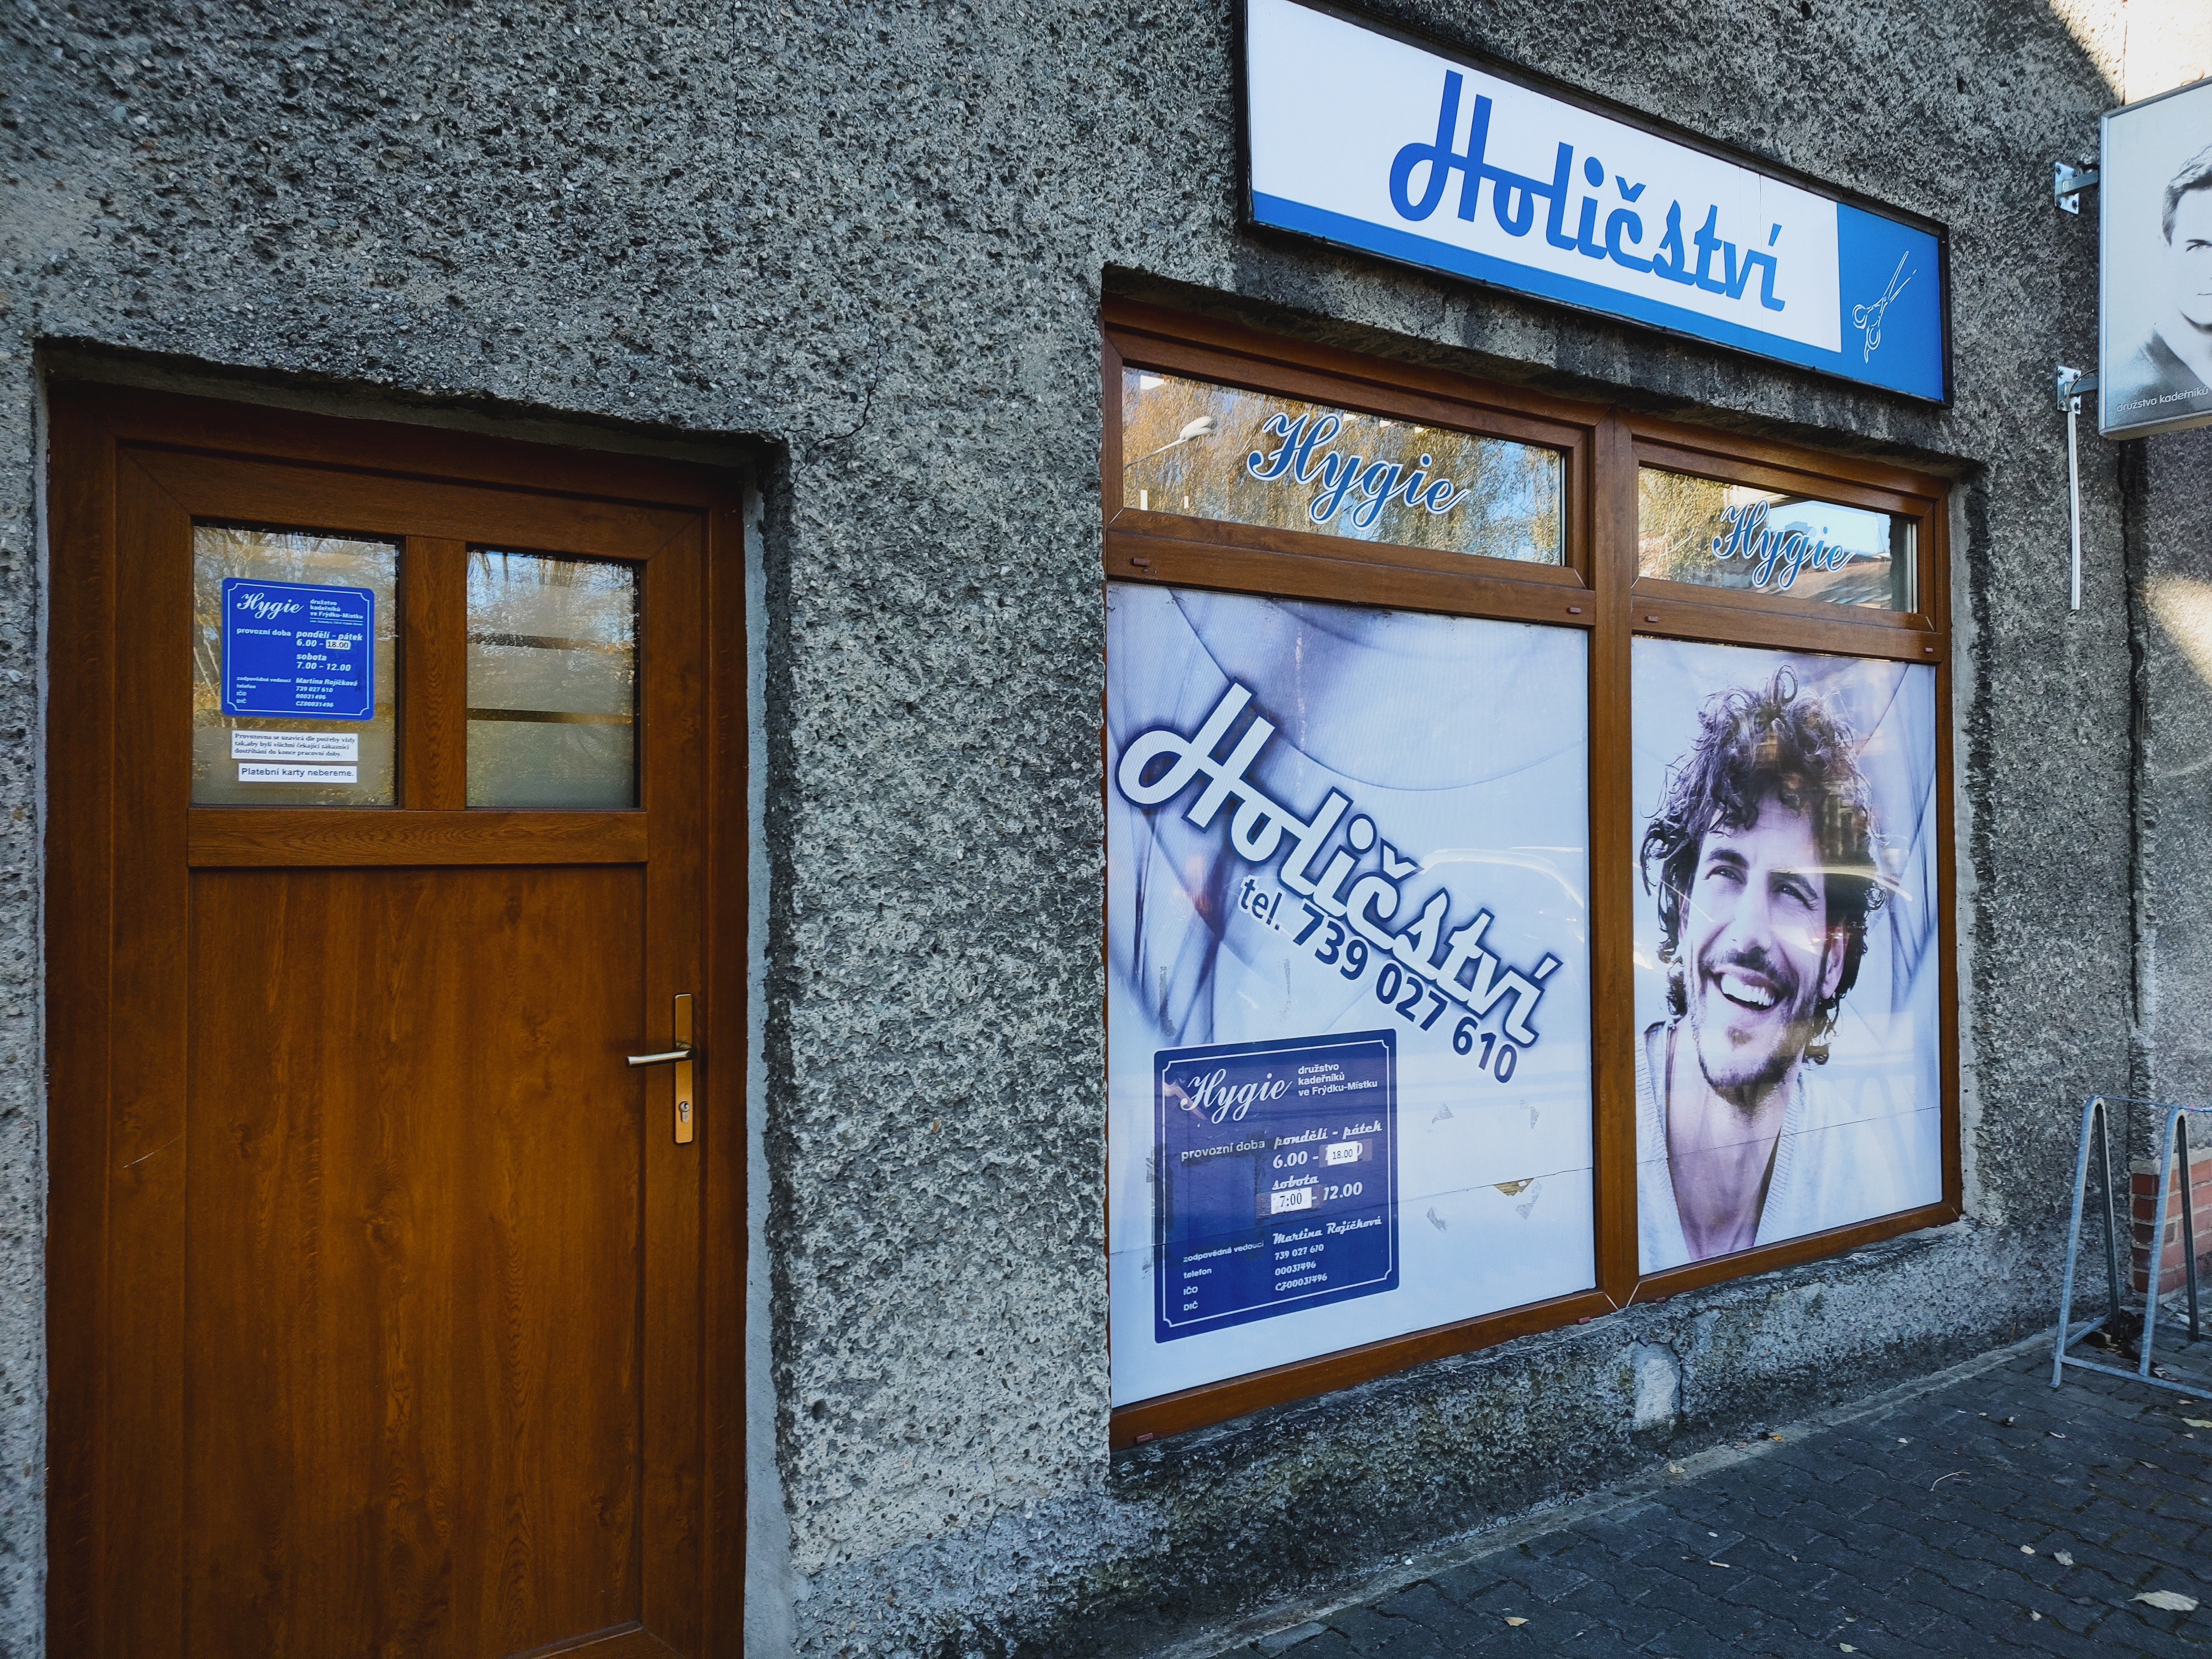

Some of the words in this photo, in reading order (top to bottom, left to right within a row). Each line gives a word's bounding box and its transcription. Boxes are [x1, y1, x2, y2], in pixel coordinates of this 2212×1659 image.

[1389, 70, 1785, 311] Holičství
[2116, 397, 2157, 412] družstvo
[1246, 411, 1471, 531] Hygie
[1711, 499, 1856, 591] Hygie
[236, 592, 304, 620] Hygie
[296, 630, 331, 639] pondělí
[296, 639, 317, 647] 6.00
[296, 653, 327, 661] sobota
[326, 663, 351, 671] 12.00
[282, 768, 305, 777] karty
[1115, 677, 1563, 1048] Holičství
[1238, 875, 1282, 931] tel.
[1291, 900, 1370, 980] 739
[1375, 961, 1449, 1031] 027
[1451, 1016, 1518, 1084] 610
[1298, 1063, 1339, 1075] družstvo
[1298, 1072, 1345, 1086] kadeřníků
[1298, 1088, 1310, 1097] ve
[1312, 1079, 1378, 1095] Frýdku-Místku
[1180, 1068, 1293, 1124] Hygie
[1274, 1128, 1328, 1150] pondělí
[1342, 1120, 1383, 1140] pátek
[1181, 1142, 1234, 1162] provozní
[1236, 1139, 1266, 1151] doba
[1272, 1151, 1308, 1168] 6.00
[1333, 1149, 1353, 1160] 18.00
[1272, 1173, 1319, 1190] sobota
[1280, 1192, 1302, 1207] 7:00
[1323, 1181, 1363, 1201] 12.00
[1272, 1228, 1323, 1245] Martina
[1326, 1215, 1382, 1234] Rojíčková
[1183, 1246, 1232, 1262] zodpovědná
[1234, 1240, 1264, 1253] vedoucí
[1275, 1250, 1290, 1261] 739
[1292, 1246, 1308, 1257] 027
[1310, 1244, 1324, 1254] 610
[1183, 1268, 1212, 1279] telefon
[1275, 1260, 1316, 1276] 00031496
[1183, 1286, 1198, 1295] IČO
[1275, 1272, 1327, 1291] CZ00031496
[1183, 1300, 1198, 1311] DIČ
